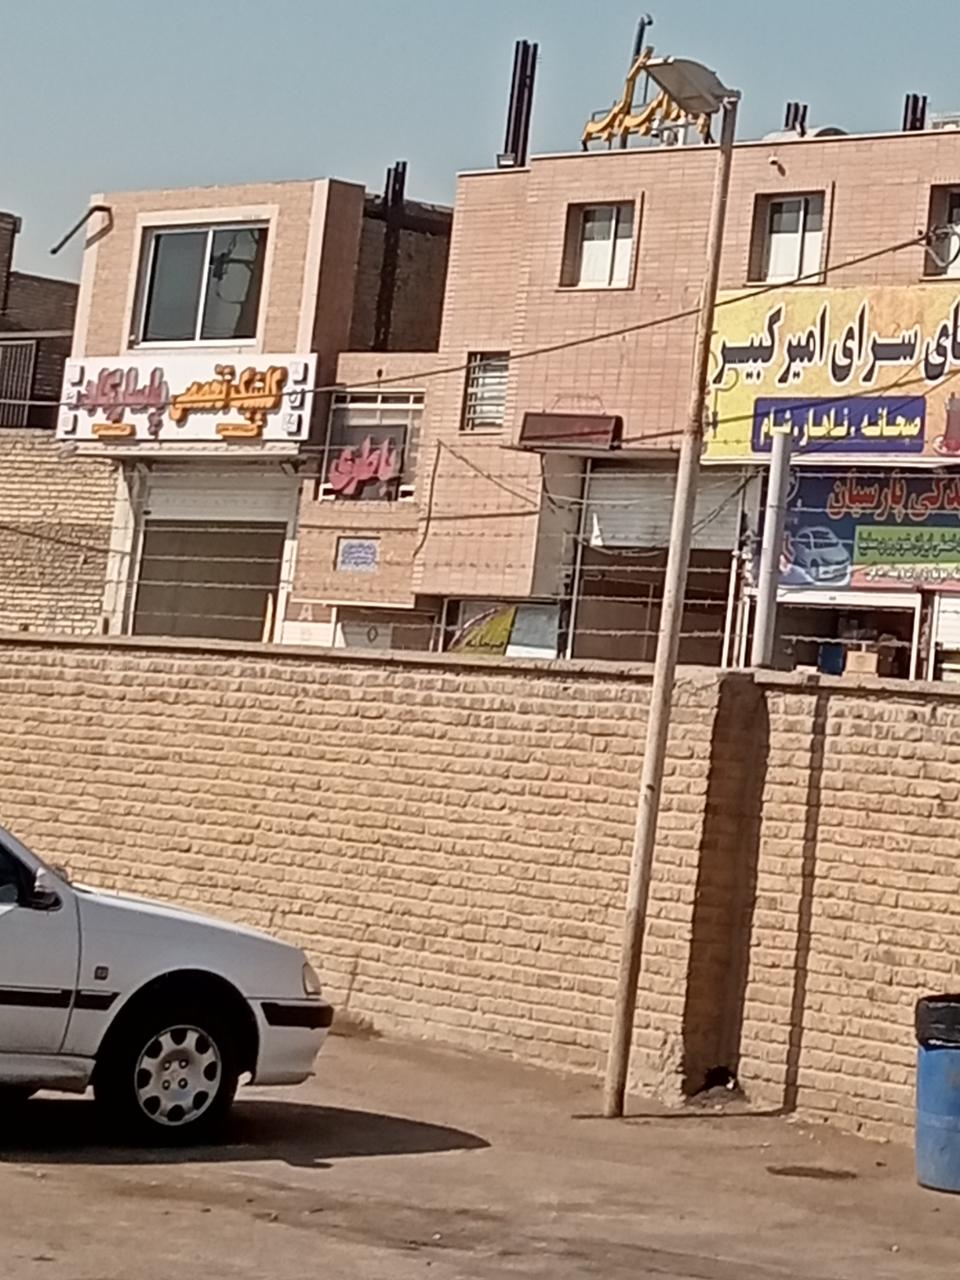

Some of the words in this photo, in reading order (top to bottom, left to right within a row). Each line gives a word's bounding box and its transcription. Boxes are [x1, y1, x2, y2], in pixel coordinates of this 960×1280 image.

[831, 302, 918, 384] سرای
[800, 407, 849, 446] ناهار
[329, 434, 397, 496] باطری
[827, 469, 906, 523] پارسیان
